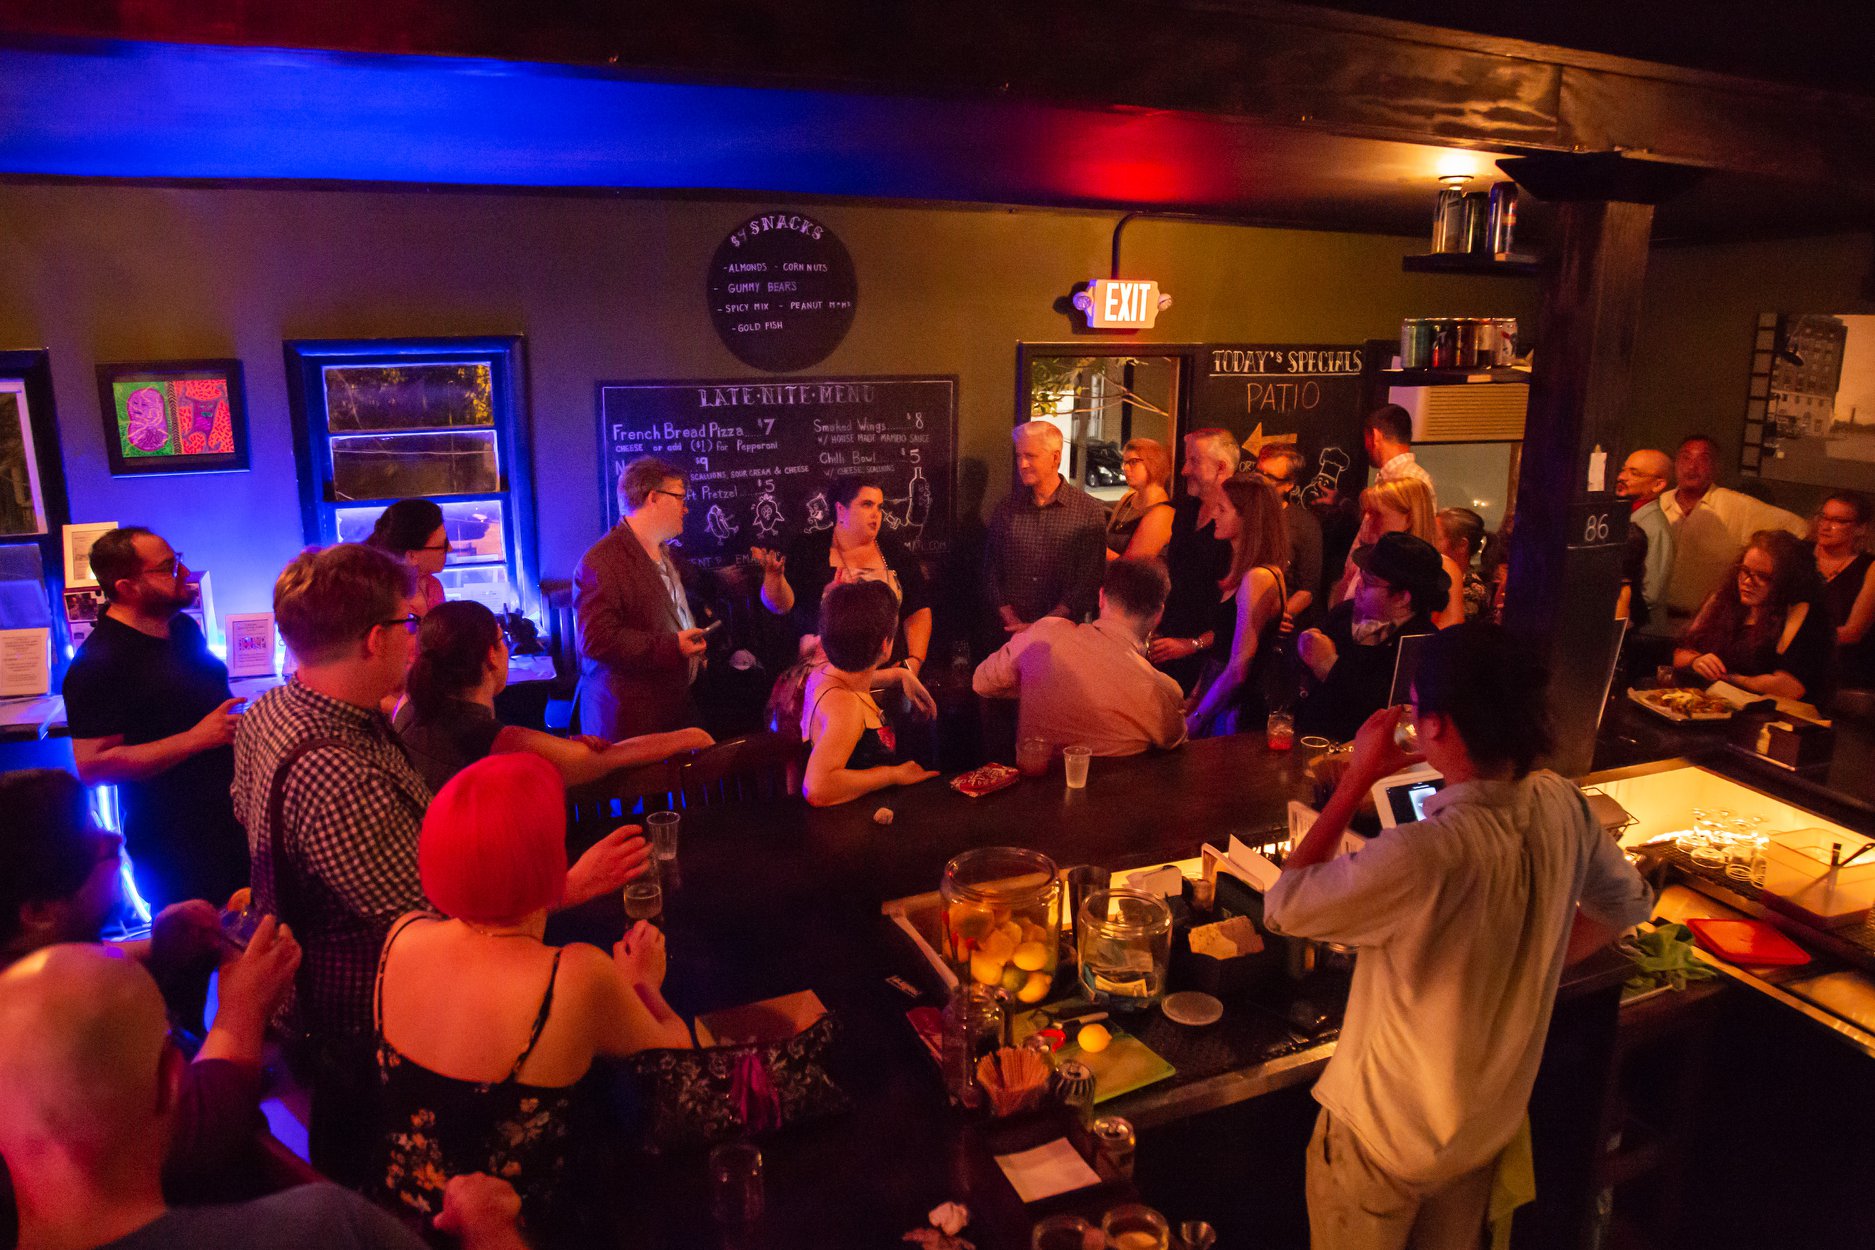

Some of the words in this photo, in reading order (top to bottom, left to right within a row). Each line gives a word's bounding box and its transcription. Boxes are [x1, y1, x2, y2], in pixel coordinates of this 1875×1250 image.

[750, 214, 824, 240] SNACKS
[728, 282, 760, 293] GUMMY
[767, 281, 797, 292] BEARS
[754, 303, 769, 311] MIX
[790, 301, 823, 310] PEANUT
[1104, 282, 1151, 322] EXIT
[765, 321, 783, 331] FISH
[1288, 350, 1363, 373] SPECIALS
[1247, 381, 1320, 414] PATIO
[613, 423, 661, 441] French
[664, 422, 706, 440] Bread
[709, 422, 745, 438] Pizza
[813, 418, 853, 433] Smoked
[857, 416, 887, 434] Wings
[615, 443, 644, 453] CHEESE
[667, 442, 682, 451] add
[716, 440, 729, 451] for
[852, 450, 876, 464] Bowl
[749, 468, 771, 477] CREAM
[774, 466, 782, 475] &
[784, 465, 810, 475] CHEESE
[702, 485, 738, 500] Pretzel
[1585, 513, 1609, 541] 86
